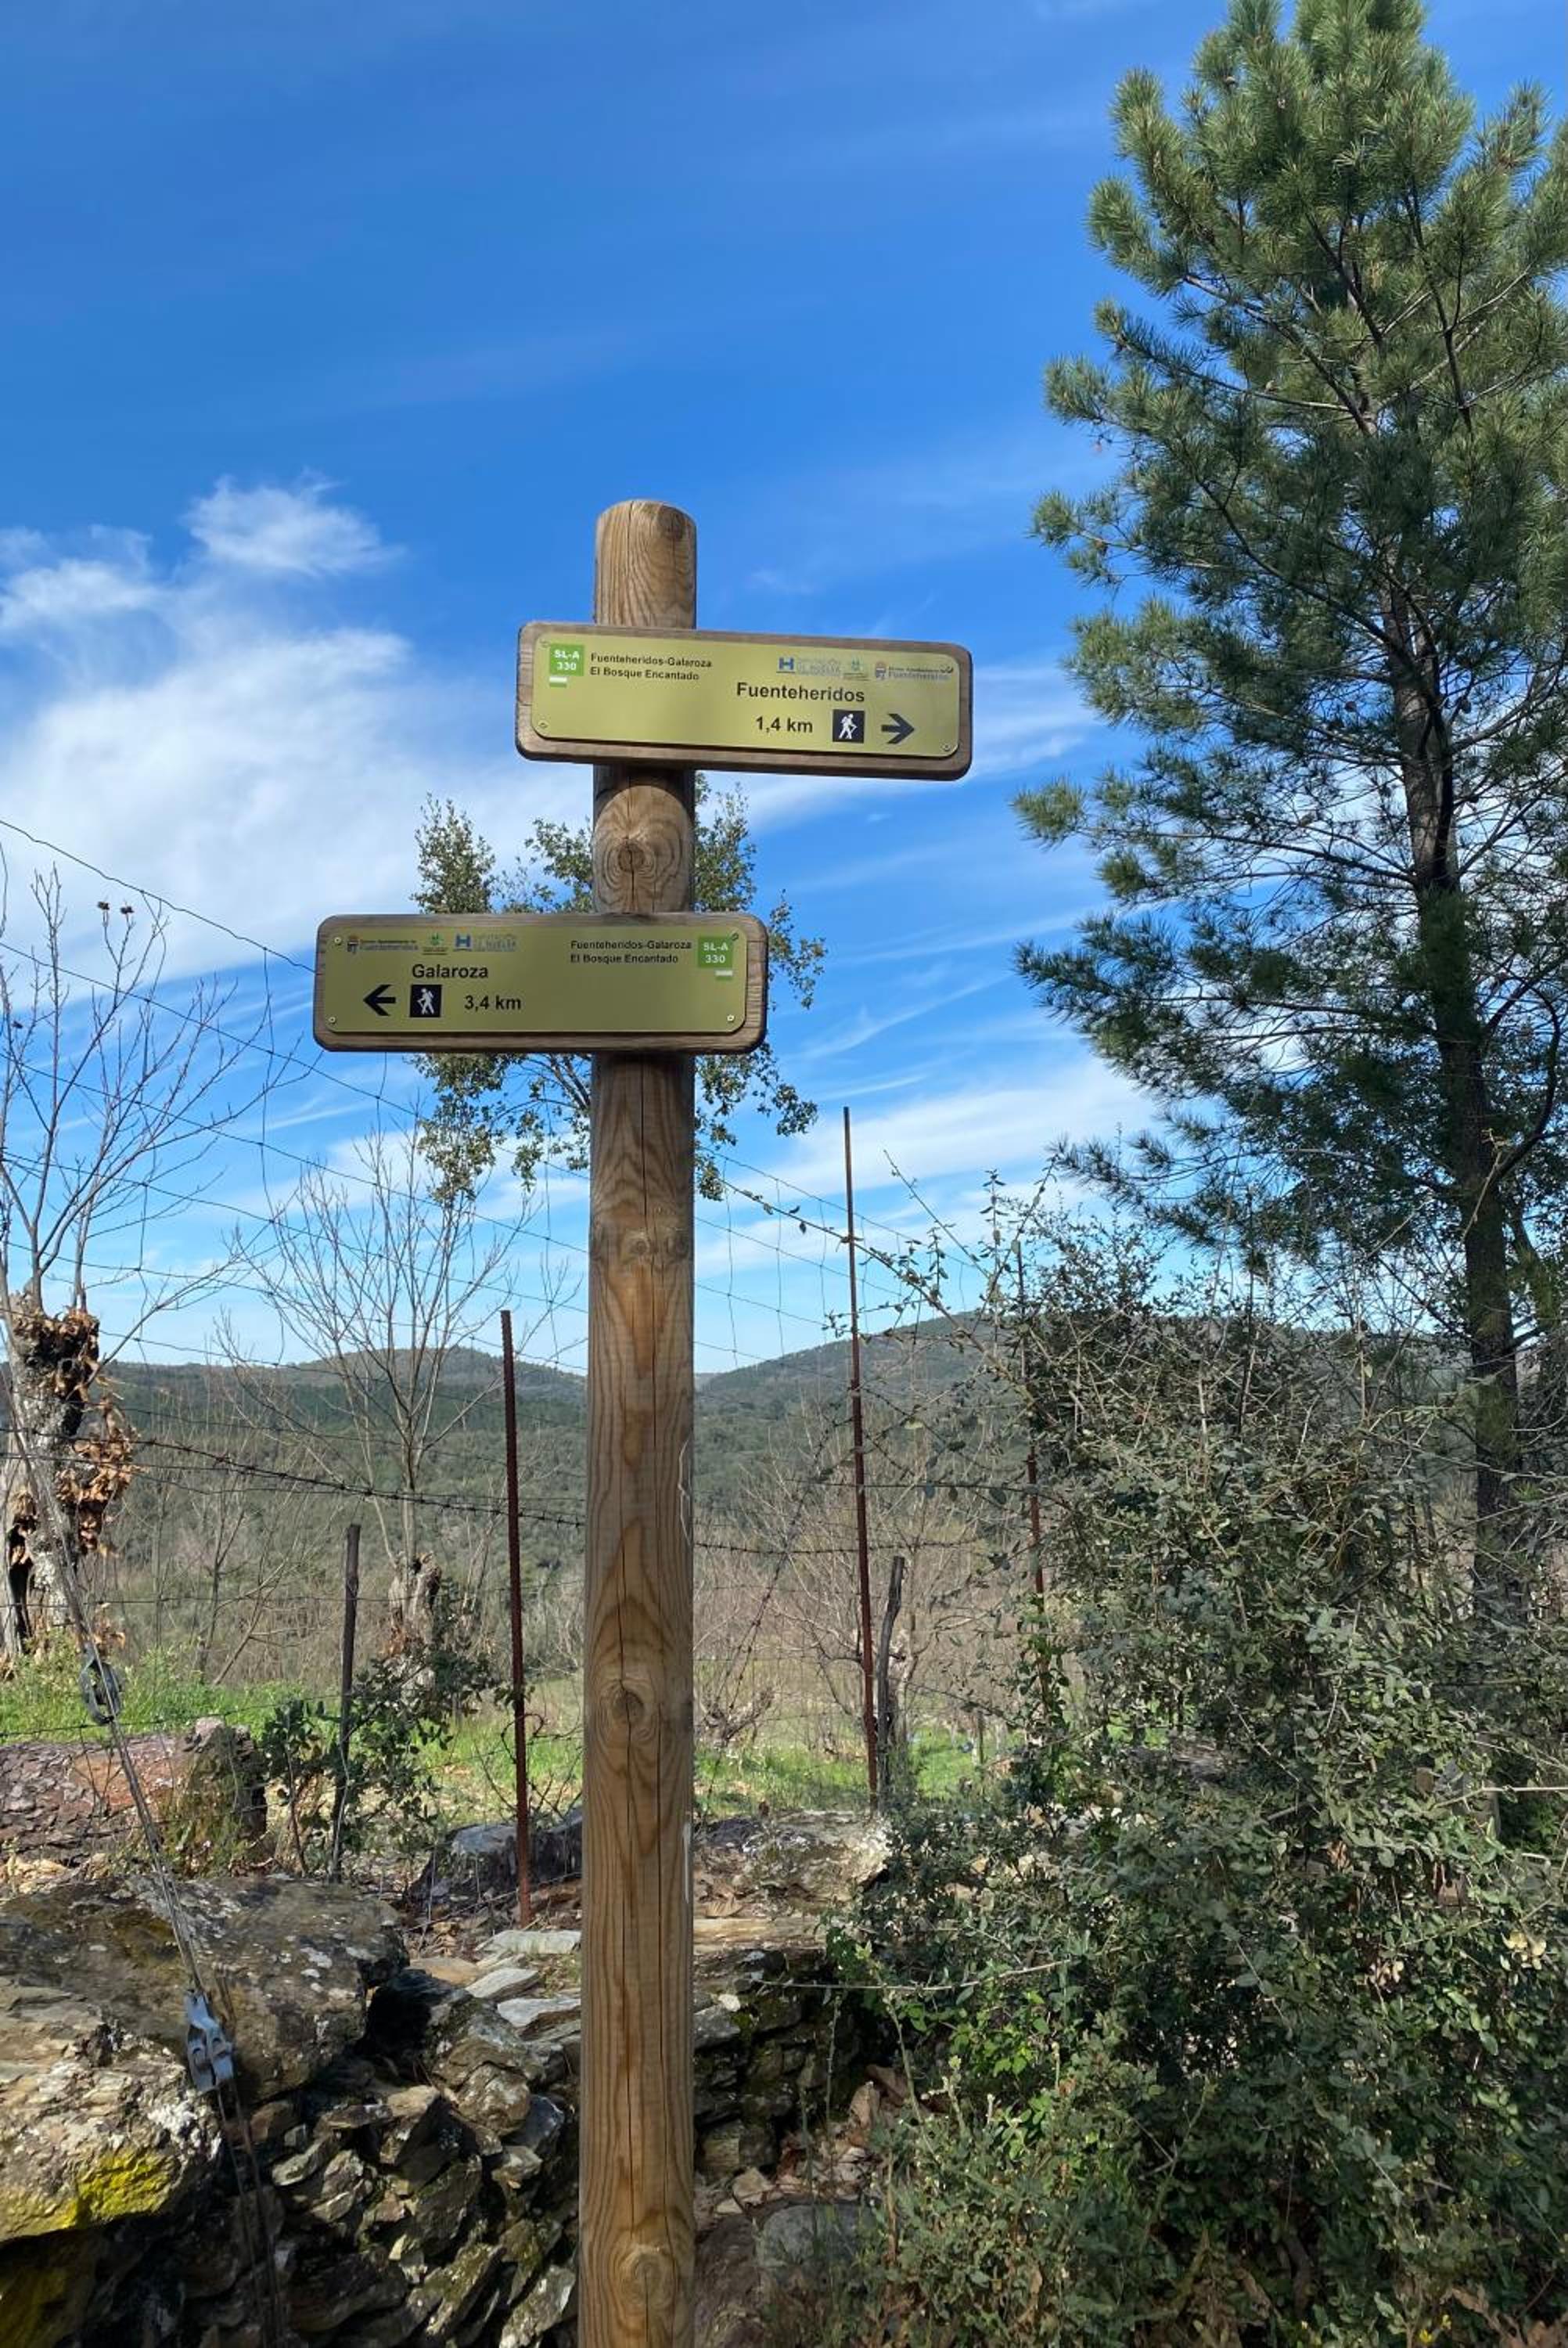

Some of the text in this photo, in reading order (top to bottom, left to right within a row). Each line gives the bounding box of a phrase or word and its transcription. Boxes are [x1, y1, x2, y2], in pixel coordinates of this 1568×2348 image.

[554, 650, 580, 659] SL-A
[591, 653, 712, 668] Fuenteheridos-Galaroza
[556, 661, 577, 671] 330
[590, 667, 699, 681] El Bosque Encantado
[736, 682, 865, 702] Fuenteheridos
[756, 716, 813, 733] 1,4 km
[570, 940, 692, 950] Fuenteheridos-Galaroza
[570, 954, 678, 965] El Bosque Encantado
[705, 954, 726, 963] 330
[412, 963, 488, 978] Galaroza
[464, 995, 521, 1011] 3,4 km
